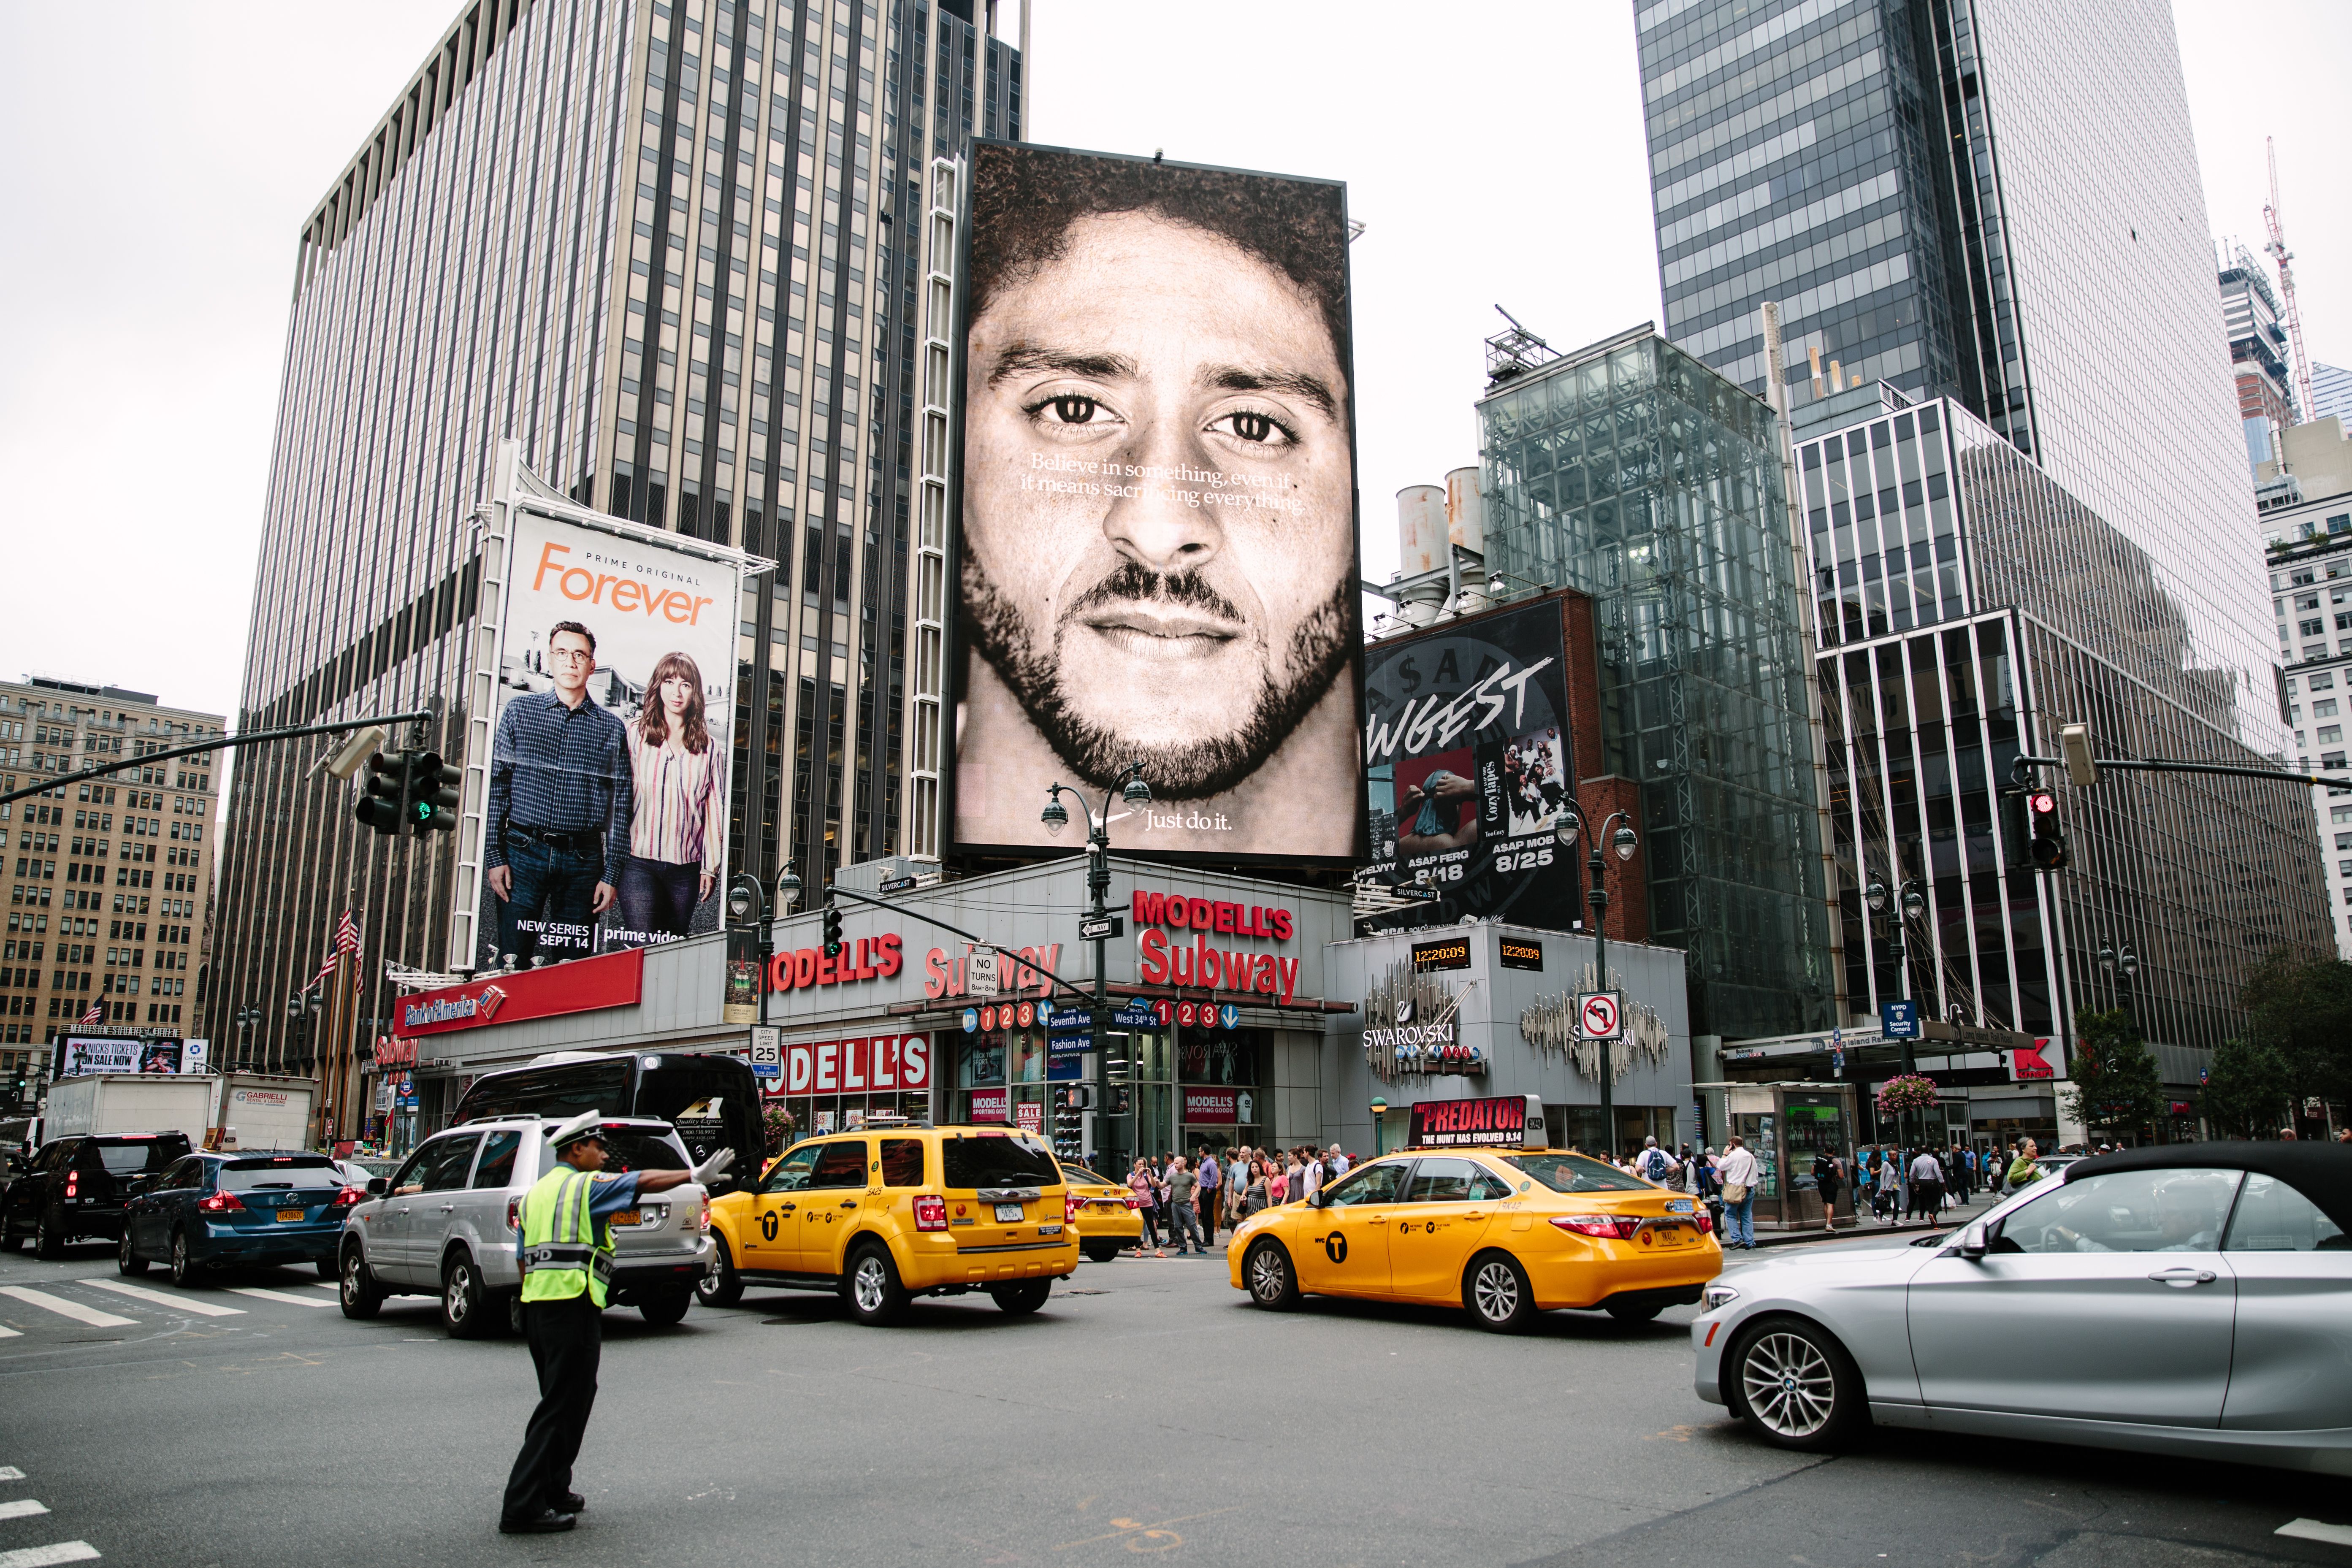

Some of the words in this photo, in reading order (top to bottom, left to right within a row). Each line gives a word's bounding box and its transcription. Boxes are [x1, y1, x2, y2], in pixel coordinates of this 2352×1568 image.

[1031, 452, 1098, 474] Believe
[1102, 459, 1121, 475] in
[1125, 462, 1227, 488] something,
[1231, 473, 1273, 487] even
[1276, 473, 1290, 489] if
[1020, 474, 1037, 490] it
[1039, 478, 1099, 496] means
[1104, 484, 1199, 508] sacrificing
[1204, 492, 1306, 516] everything.
[586, 552, 628, 569] PRIME
[636, 565, 700, 586] ORIGINAL
[533, 542, 713, 626] Forever
[1367, 656, 1554, 765] WGEST
[1145, 810, 1183, 831] Just
[1186, 811, 1211, 830] do
[1214, 813, 1232, 831] it.
[1493, 840, 1524, 854] A$AP
[1527, 835, 1555, 849] MOB
[1408, 856, 1437, 868] A$AP
[1439, 850, 1469, 864] FERG
[1496, 849, 1553, 872] 8/25
[1358, 862, 1396, 876] WELVYY
[1415, 864, 1463, 885] 8/18
[882, 879, 910, 892] SILVERCAST
[1397, 888, 1435, 898] SILVERCAST
[1133, 890, 1293, 940] MODELL'S
[517, 919, 547, 932] NEW
[549, 923, 589, 936] SERIES
[603, 927, 646, 942] prime
[539, 934, 569, 947] SEPT
[573, 936, 588, 948] 14
[1416, 946, 1465, 962] 12:20:09
[1502, 945, 1539, 959] 12:20:09
[925, 943, 1063, 999] Suway
[977, 959, 990, 969] NO
[1138, 928, 1299, 1006] Subway
[971, 972, 995, 982] TURNS
[972, 984, 995, 992] 8AM-8PM
[405, 1002, 426, 1027] Bank
[427, 999, 438, 1021] of
[436, 994, 476, 1021] America
[963, 1013, 977, 1028] MTA
[1003, 1009, 1011, 1024] 2
[1021, 1006, 1030, 1022] 3
[1051, 1015, 1076, 1026] Seventh
[1078, 1014, 1090, 1023] Ave
[1115, 1013, 1133, 1024] West
[1135, 1015, 1147, 1024] 34th
[1149, 1016, 1157, 1026] St
[1363, 1024, 1453, 1047] SWAROVSKI
[1848, 1037, 1870, 1045] Island
[1963, 1029, 1975, 1041] Long
[1975, 1031, 1989, 1041] Island
[2000, 1033, 2013, 1043] Road
[84, 1043, 108, 1054] KNICKS
[111, 1044, 138, 1055] TICKETS
[376, 1035, 420, 1067] Subway
[1052, 1040, 1076, 1050] Fashion
[1077, 1038, 1090, 1048] Ave
[82, 1055, 93, 1064] ON
[94, 1055, 112, 1065] SALE
[114, 1056, 132, 1066] NOW
[756, 1048, 775, 1061] 25
[647, 1059, 657, 1067] 30
[760, 1037, 926, 1092] DELL'S
[2016, 1069, 2054, 1078] kmart
[247, 1092, 287, 1100] GABRIELLI
[973, 1097, 1006, 1108] MODELL'
[1187, 1096, 1233, 1107] MODELL'S
[1018, 1109, 1041, 1117] SALE
[1414, 1105, 1425, 1113] THE
[1423, 1099, 1524, 1132] PREDATOR
[1530, 1119, 1541, 1129] 9K42
[1422, 1135, 1435, 1144] THE
[1436, 1134, 1455, 1144] HUNT
[1457, 1133, 1470, 1143] HAS
[1472, 1132, 1504, 1143] EVOLVED
[1506, 1132, 1521, 1142] 9.14
[867, 1187, 883, 1196] 5A25
[1501, 1202, 1521, 1210] 9K42
